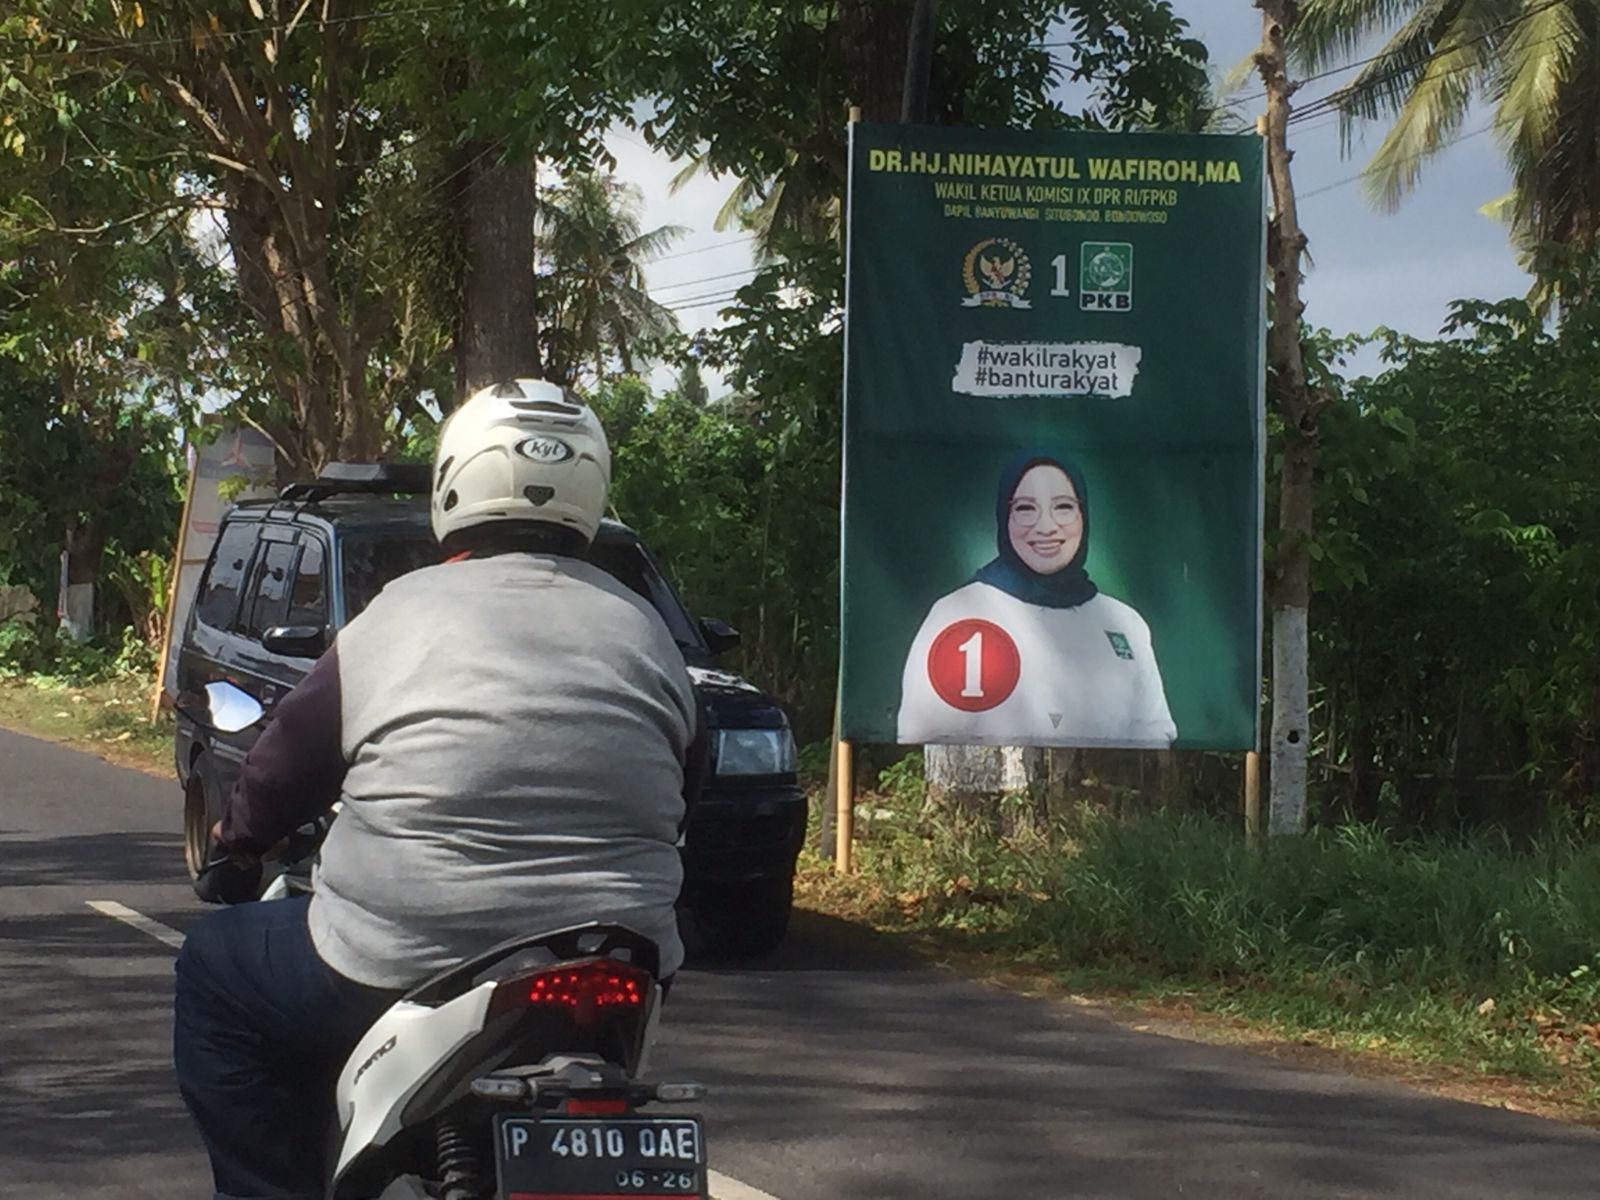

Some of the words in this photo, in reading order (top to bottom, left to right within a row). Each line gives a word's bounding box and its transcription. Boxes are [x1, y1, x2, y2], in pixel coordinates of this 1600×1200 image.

[869, 149, 1081, 179] DR.HJ.NIHAYATUL
[1088, 158, 1242, 186] WAFIROH,MA
[935, 182, 977, 200] WAKIL
[981, 184, 1022, 202] KETUA
[1026, 186, 1073, 204] KOMISI
[1077, 188, 1091, 205] IX
[1094, 188, 1121, 206] DPR
[1124, 189, 1178, 207] RI/FPKB
[944, 204, 973, 219] DAPIL
[1049, 254, 1070, 297] 1
[1081, 293, 1132, 310] PKB
[977, 347, 1118, 374] #wakilrakyat
[974, 366, 1119, 392] #banturakyat
[958, 631, 985, 699] 1
[512, 1126, 529, 1157] P
[551, 1127, 625, 1158] 4810
